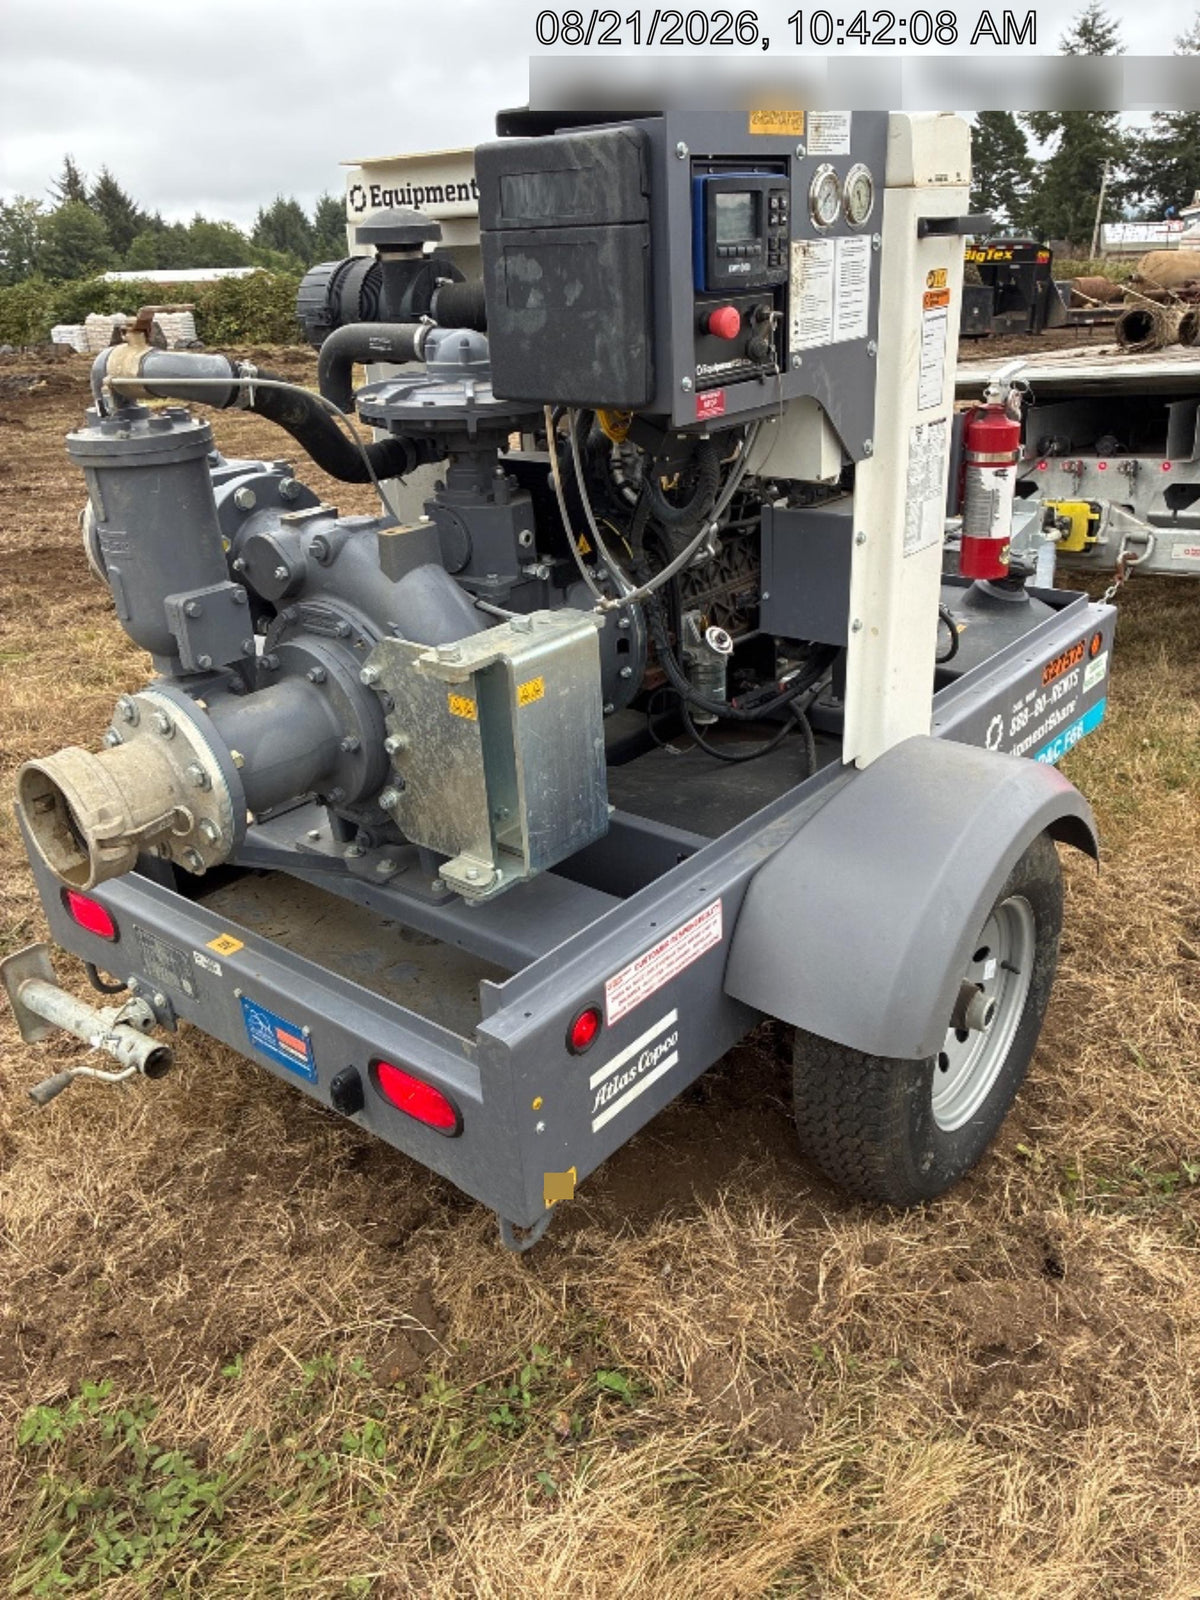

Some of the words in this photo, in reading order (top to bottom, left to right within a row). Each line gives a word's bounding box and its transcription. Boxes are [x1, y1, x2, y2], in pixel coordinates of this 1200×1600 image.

[369, 178, 479, 210] Equipment
[592, 1065, 637, 1113] Atlas
[638, 1030, 679, 1072] Copco
